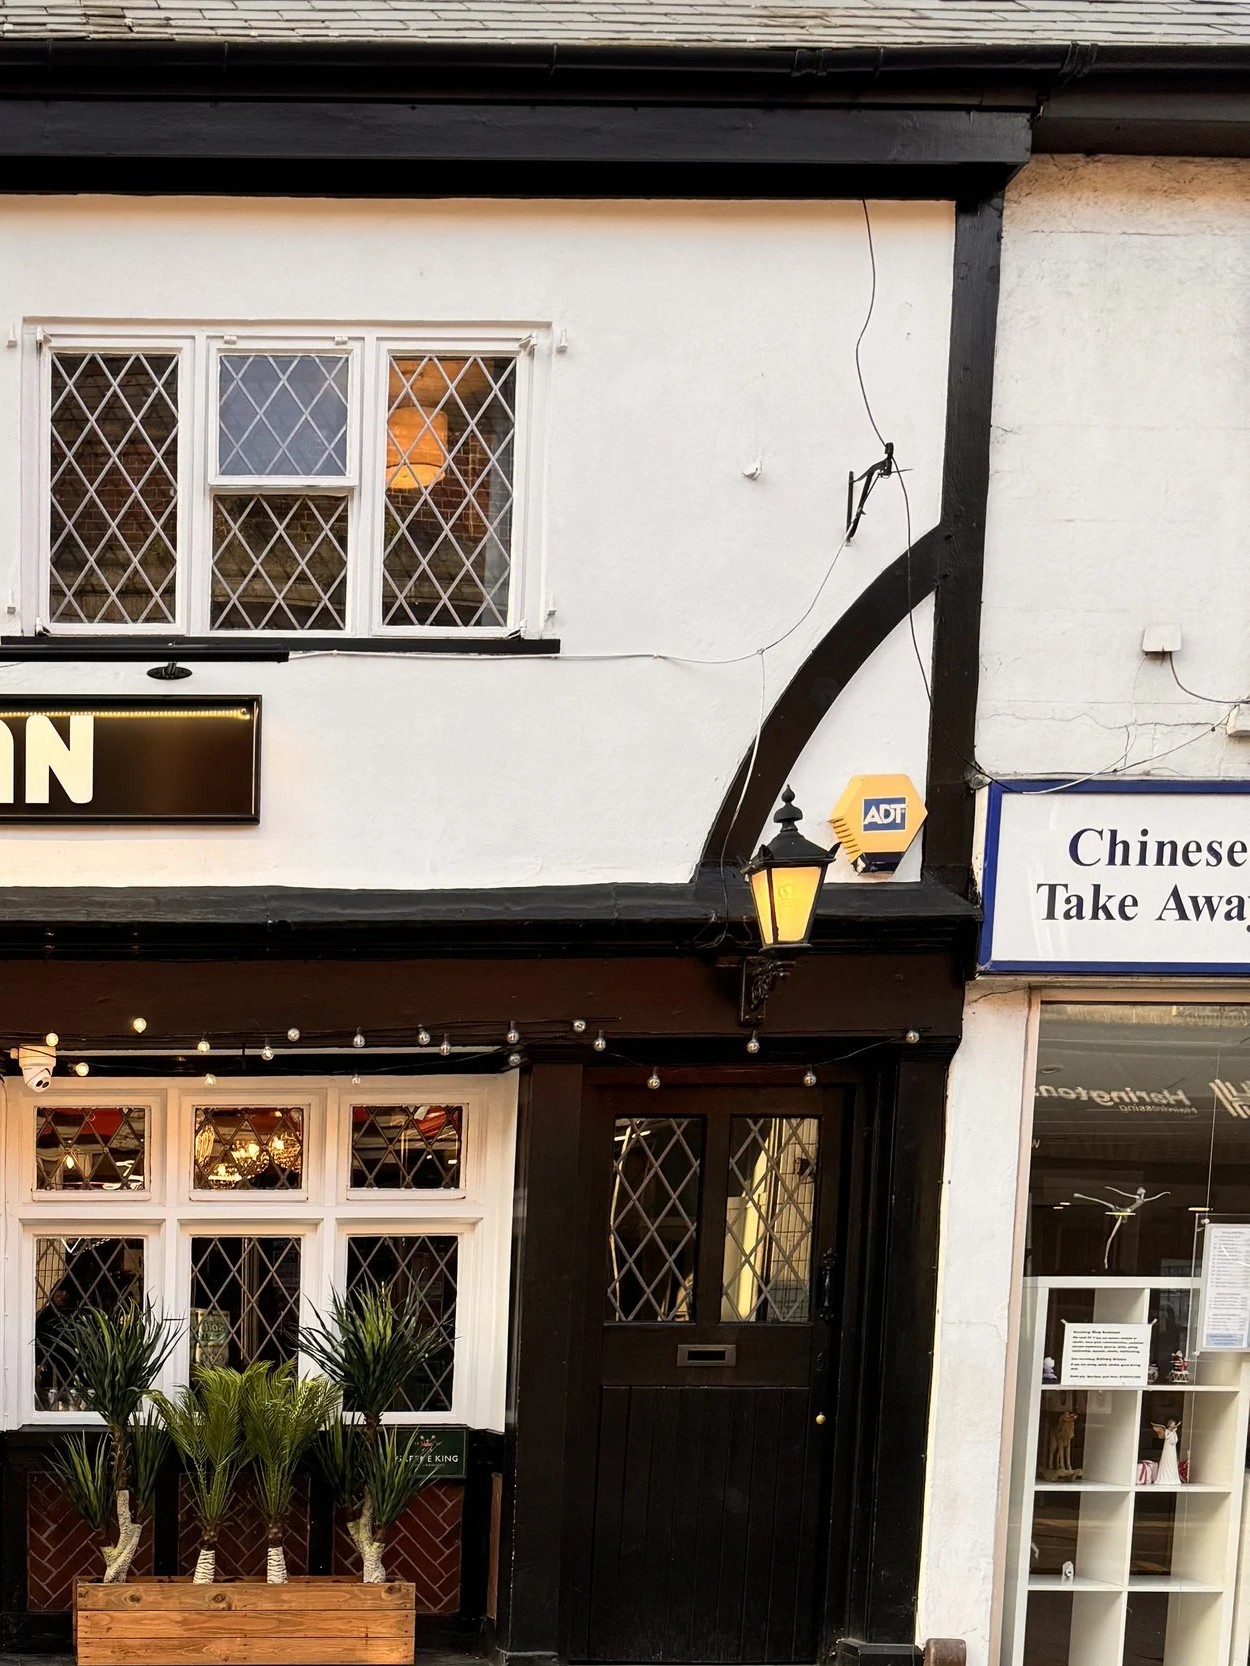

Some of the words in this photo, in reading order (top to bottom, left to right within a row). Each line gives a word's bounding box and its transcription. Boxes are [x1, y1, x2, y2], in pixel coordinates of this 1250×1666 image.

[863, 804, 907, 825] ADT
[1068, 828, 1248, 867] Chinese
[1036, 883, 1139, 921] Take
[1155, 884, 1250, 933] Awa
[435, 1454, 459, 1463] KING
